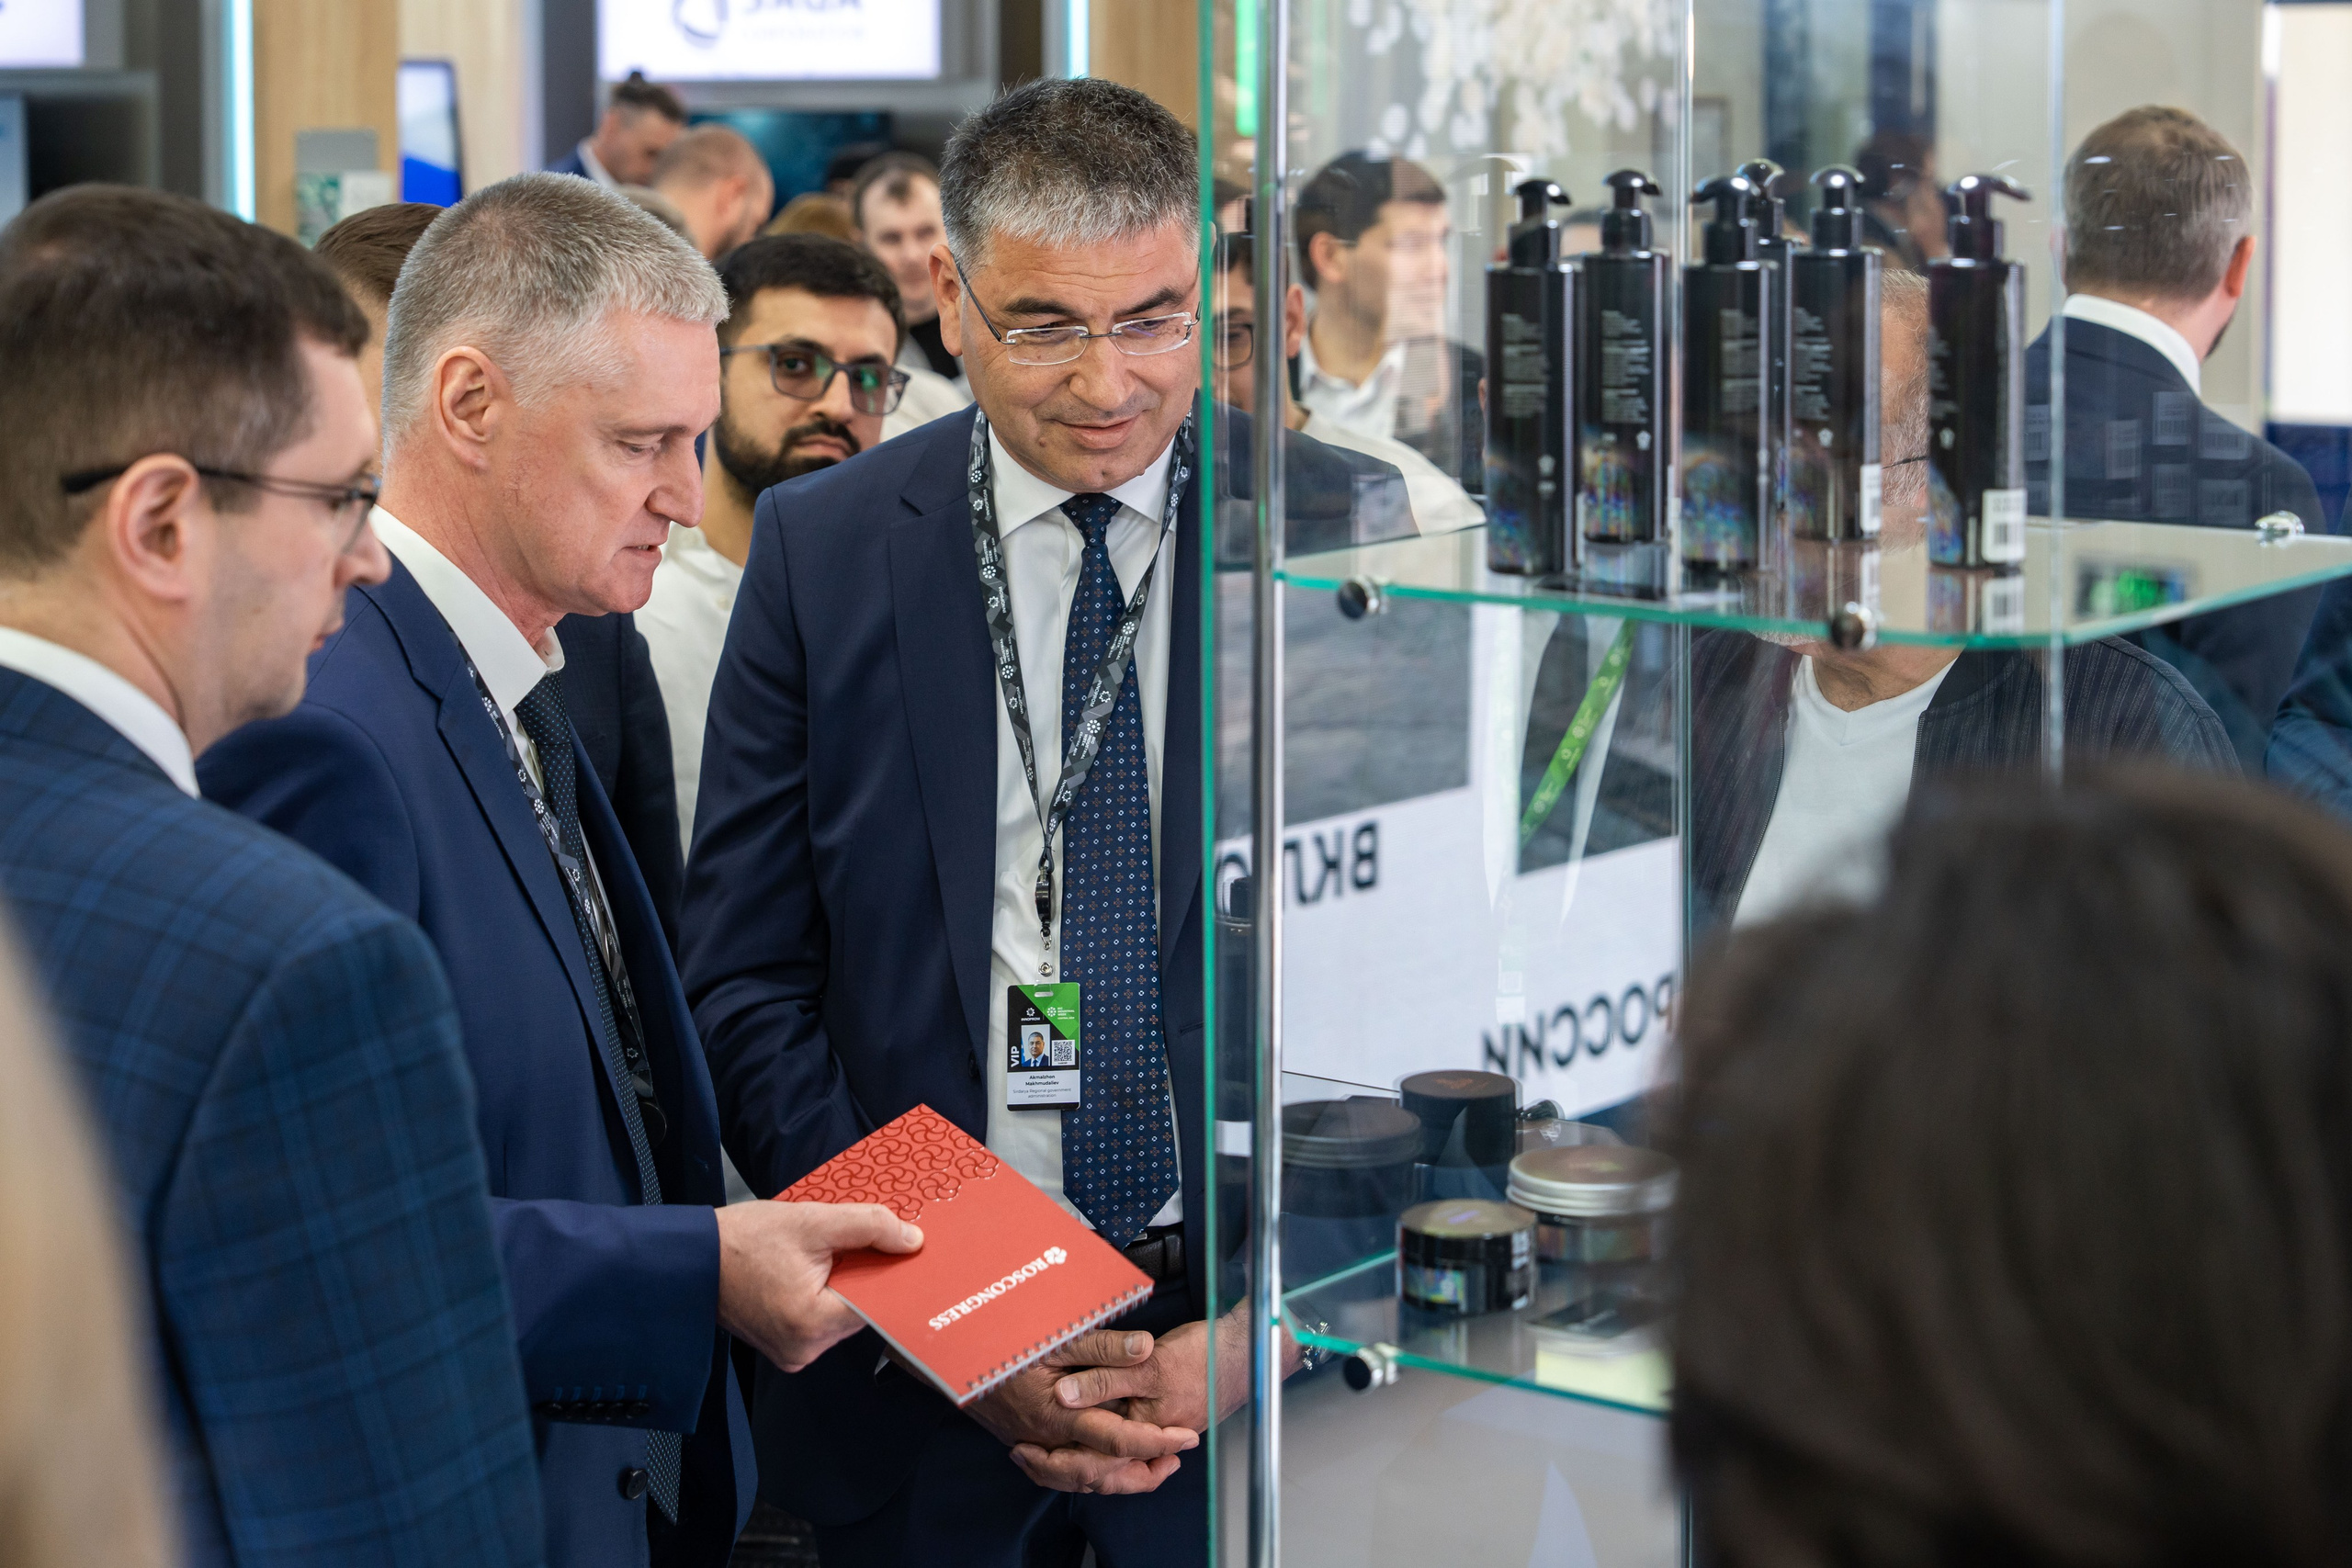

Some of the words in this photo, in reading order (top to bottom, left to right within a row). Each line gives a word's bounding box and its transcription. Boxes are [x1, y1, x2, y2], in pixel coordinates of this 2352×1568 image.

[982, 489, 990, 516] INNOPROM
[998, 585, 1007, 614] INNOPROM
[1110, 634, 1119, 650] CENTRAL
[1115, 636, 1126, 660] INDUSTRIAL
[1015, 685, 1024, 715] INNOPROM
[1089, 679, 1102, 707] INNOPROM
[489, 712, 505, 739] INDUSTRIAL
[1075, 731, 1083, 748] CENTRAL
[1080, 734, 1092, 760] INDUSTRIAL
[1052, 778, 1067, 807] INNOPROM
[1011, 1046, 1020, 1067] VIP
[929, 1257, 1049, 1331] ROSCONGRESS
